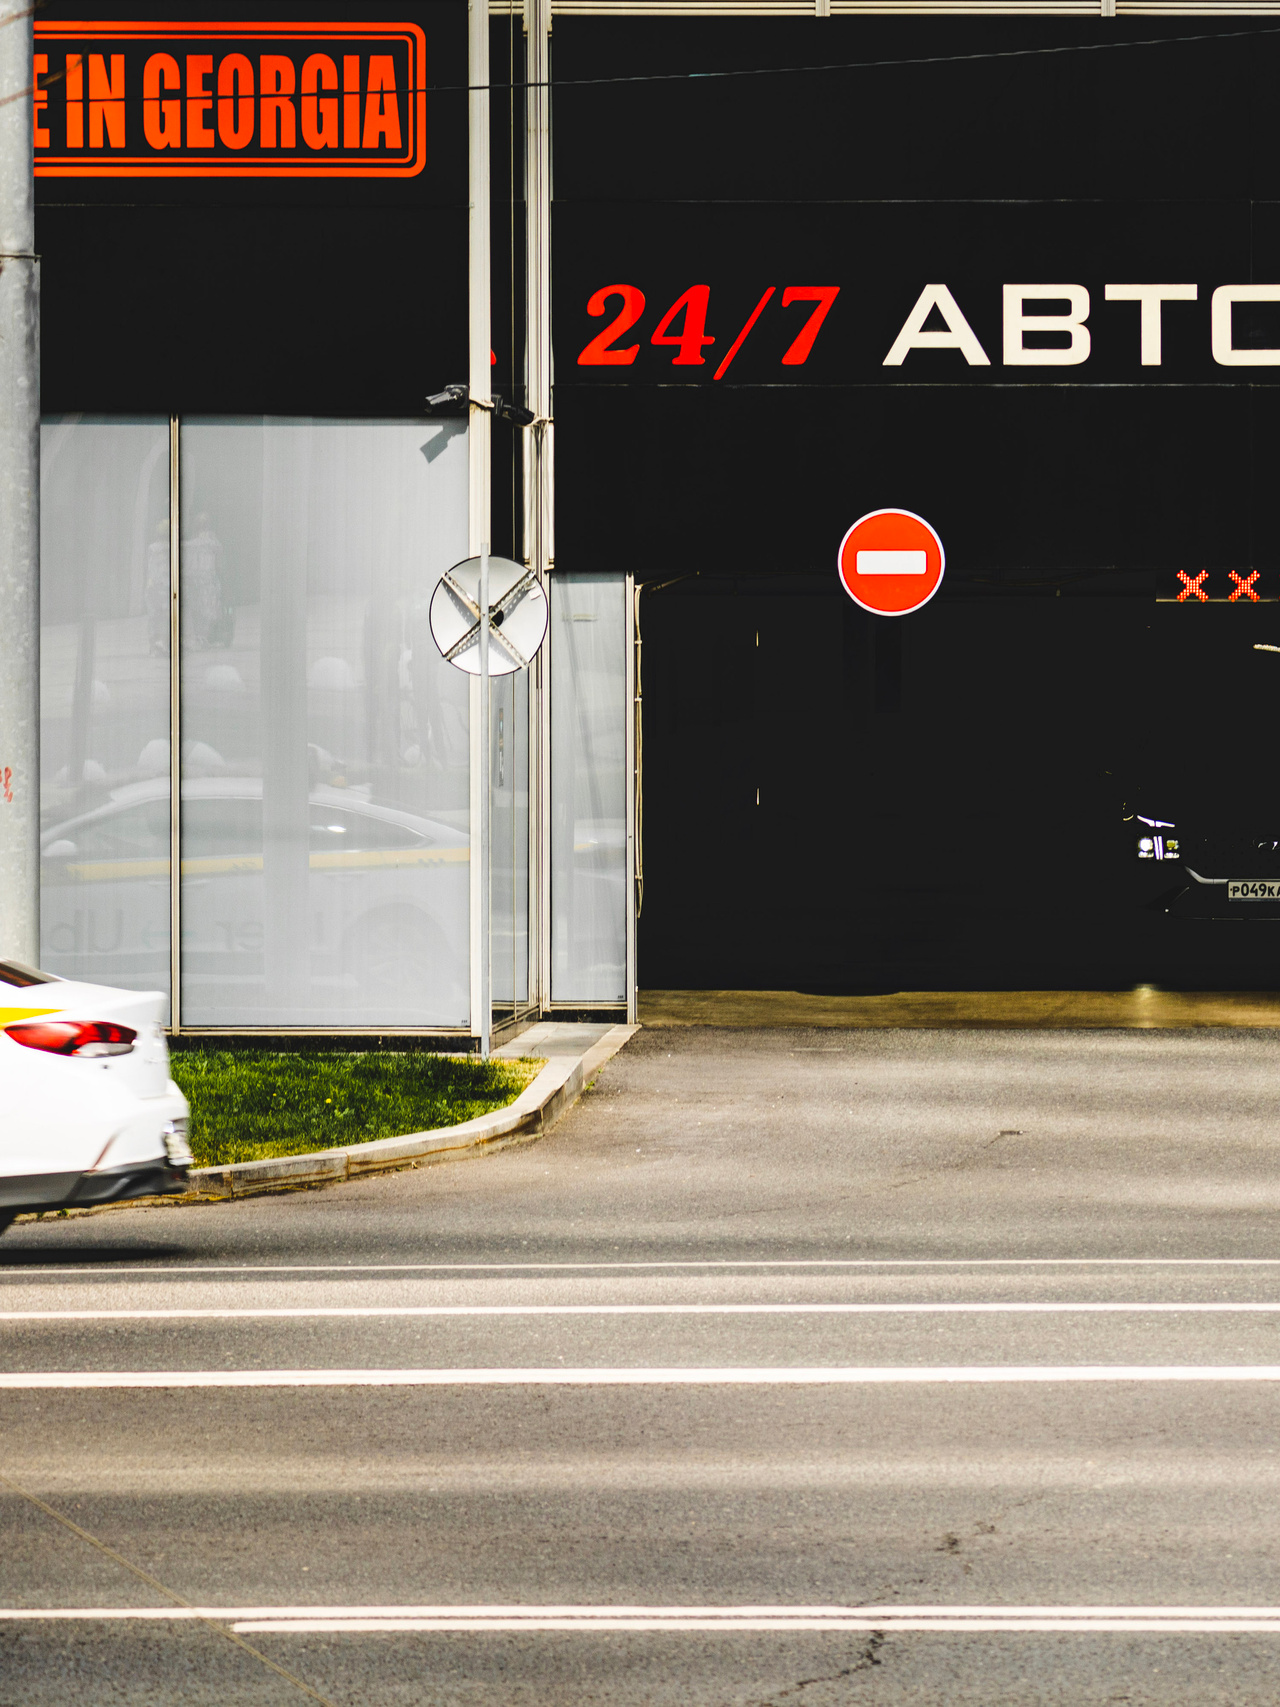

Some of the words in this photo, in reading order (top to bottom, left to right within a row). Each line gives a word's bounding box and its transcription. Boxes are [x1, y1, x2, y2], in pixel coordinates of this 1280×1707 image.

[66, 54, 126, 149] IN
[143, 53, 402, 150] GEORGIA
[577, 283, 841, 380] 24/7
